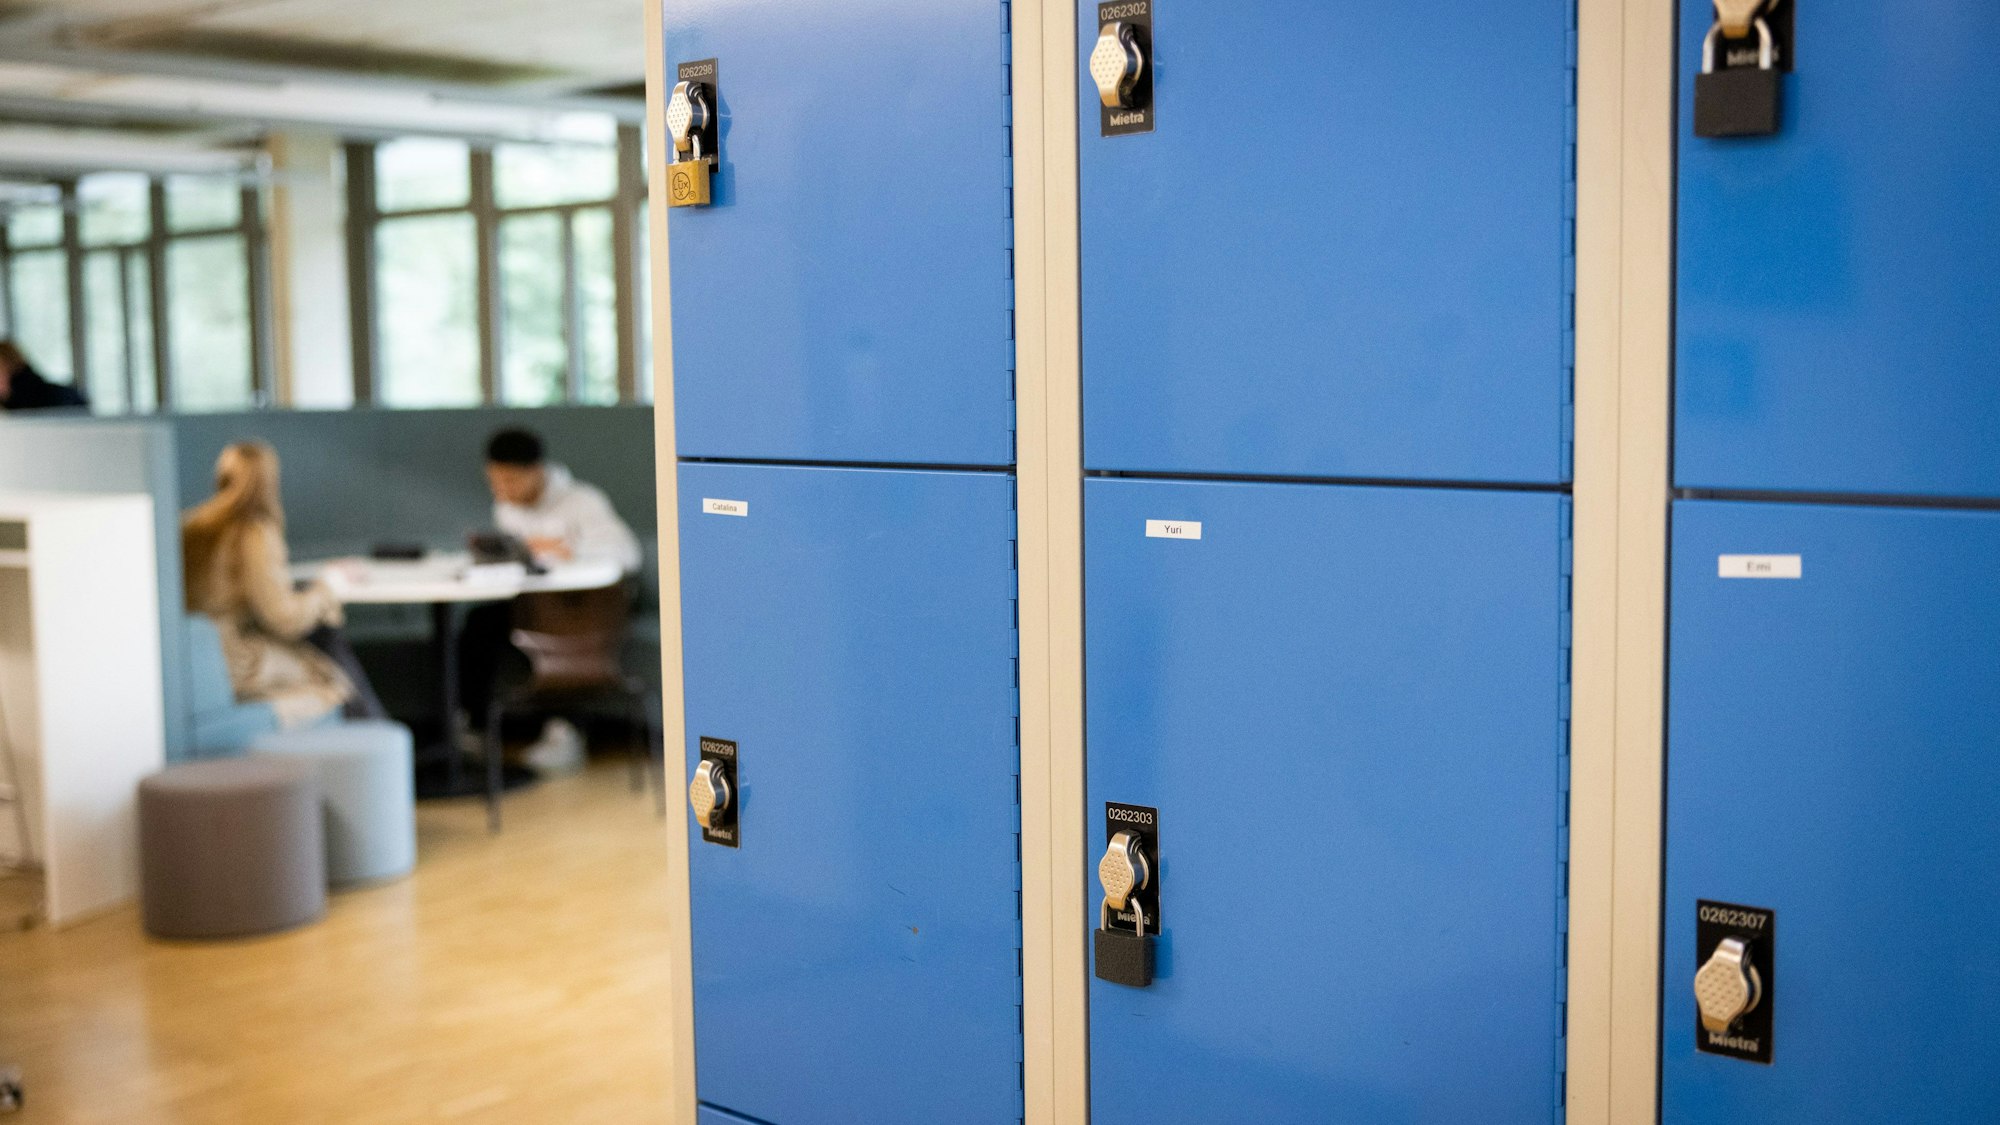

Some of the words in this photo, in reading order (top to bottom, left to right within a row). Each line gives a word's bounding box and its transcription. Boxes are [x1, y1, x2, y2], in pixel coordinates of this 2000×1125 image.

[1101, 2, 1147, 20] 0262302
[680, 64, 713, 79] 0262298
[1110, 113, 1144, 127] Mietra
[712, 502, 738, 512] Catalina
[1164, 525, 1182, 534] Yuri
[1747, 561, 1771, 572] Emi
[701, 741, 734, 756] 0262299
[1108, 808, 1153, 825] 0262303
[1117, 911, 1150, 925] Miea
[1700, 906, 1767, 929] 0262307
